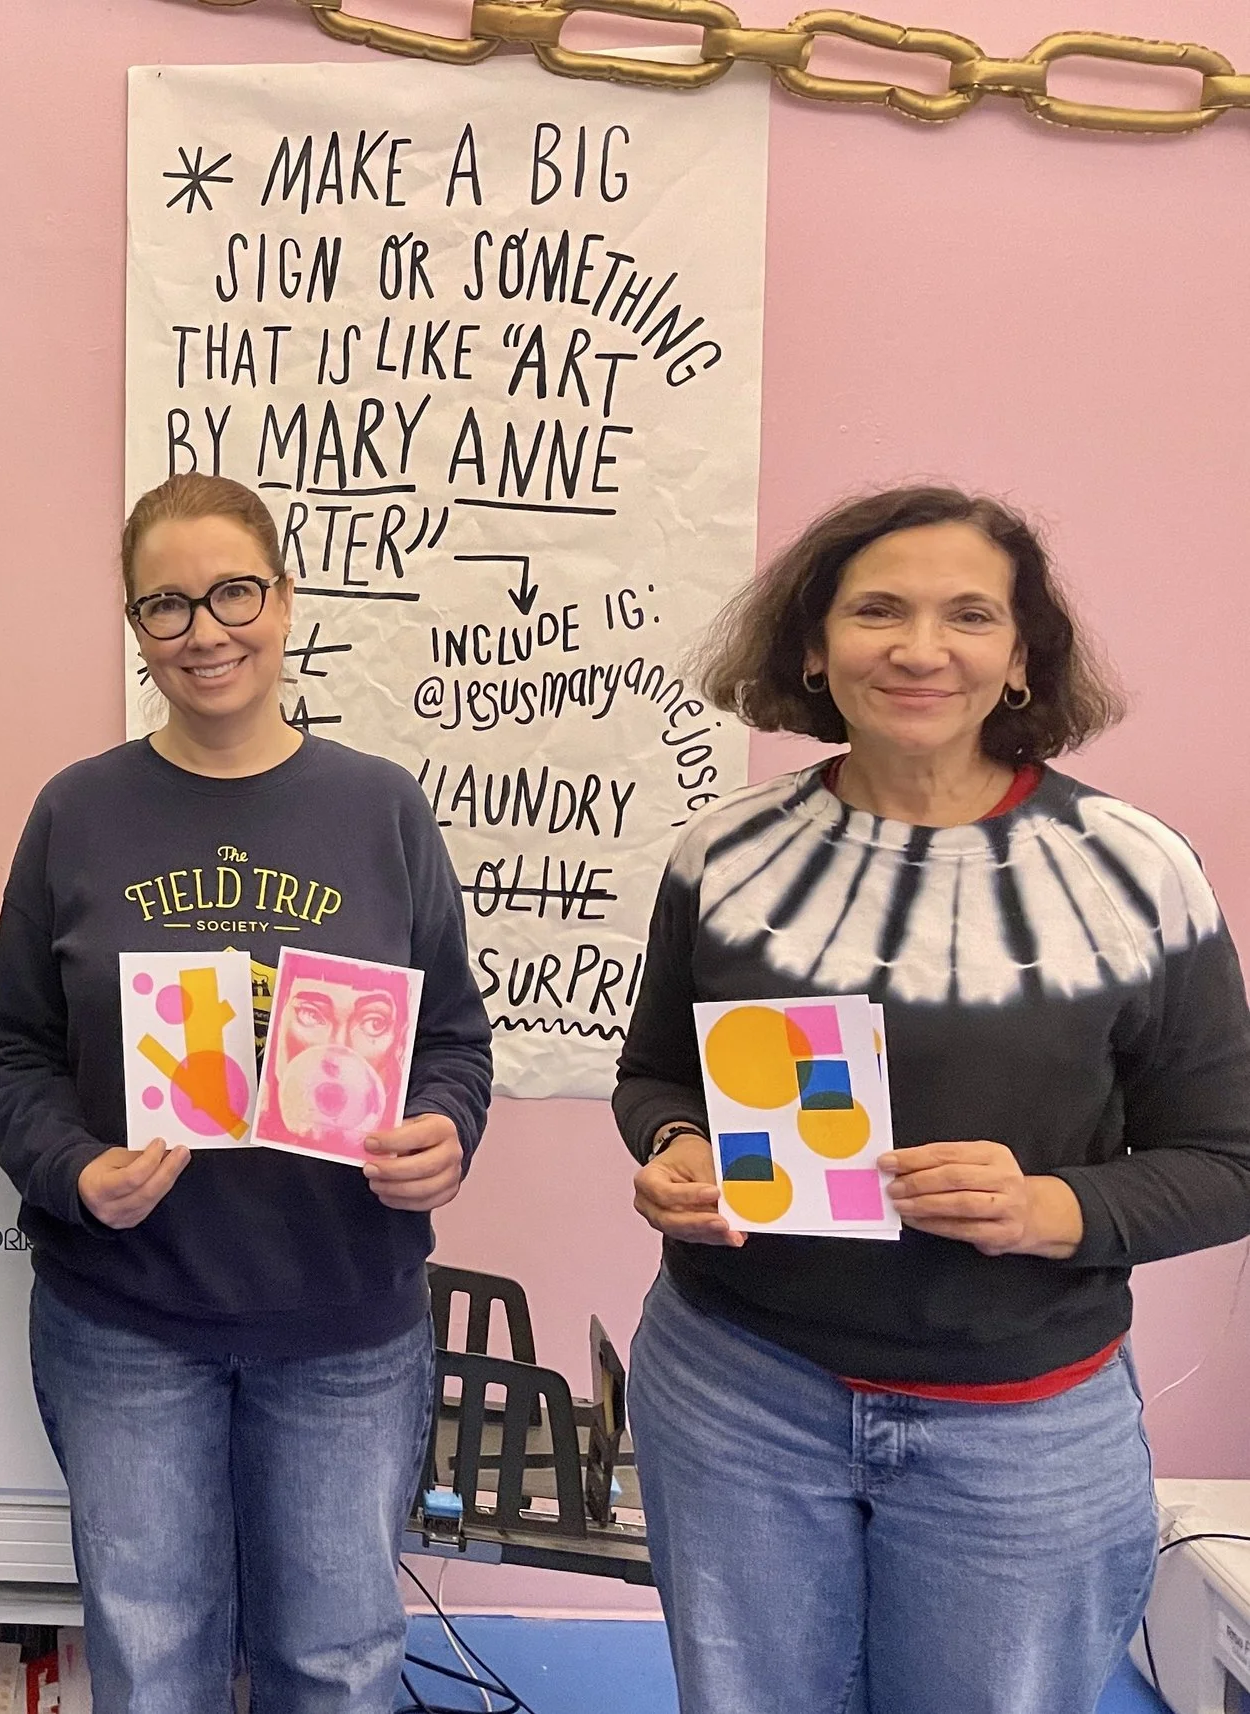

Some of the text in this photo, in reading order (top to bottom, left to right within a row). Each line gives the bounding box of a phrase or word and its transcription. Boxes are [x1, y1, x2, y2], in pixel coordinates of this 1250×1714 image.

[260, 123, 630, 214] MAKE A BIG
[216, 228, 722, 387] SIGN OR SOMETHING
[172, 317, 638, 418] THAT IS LIKE "ART
[167, 394, 634, 500] BY MARY ANNE
[282, 502, 449, 586] RTER"
[431, 584, 660, 668] INCLUDE IG:
[413, 657, 722, 827] @jesusmaryannejose
[431, 764, 636, 838] LAUNDRY
[124, 866, 342, 925] FIELD TRIP
[217, 845, 249, 863] The
[473, 855, 613, 920] OLIVE
[196, 920, 270, 932] SOCIETY
[478, 945, 643, 1016] SURPRI
